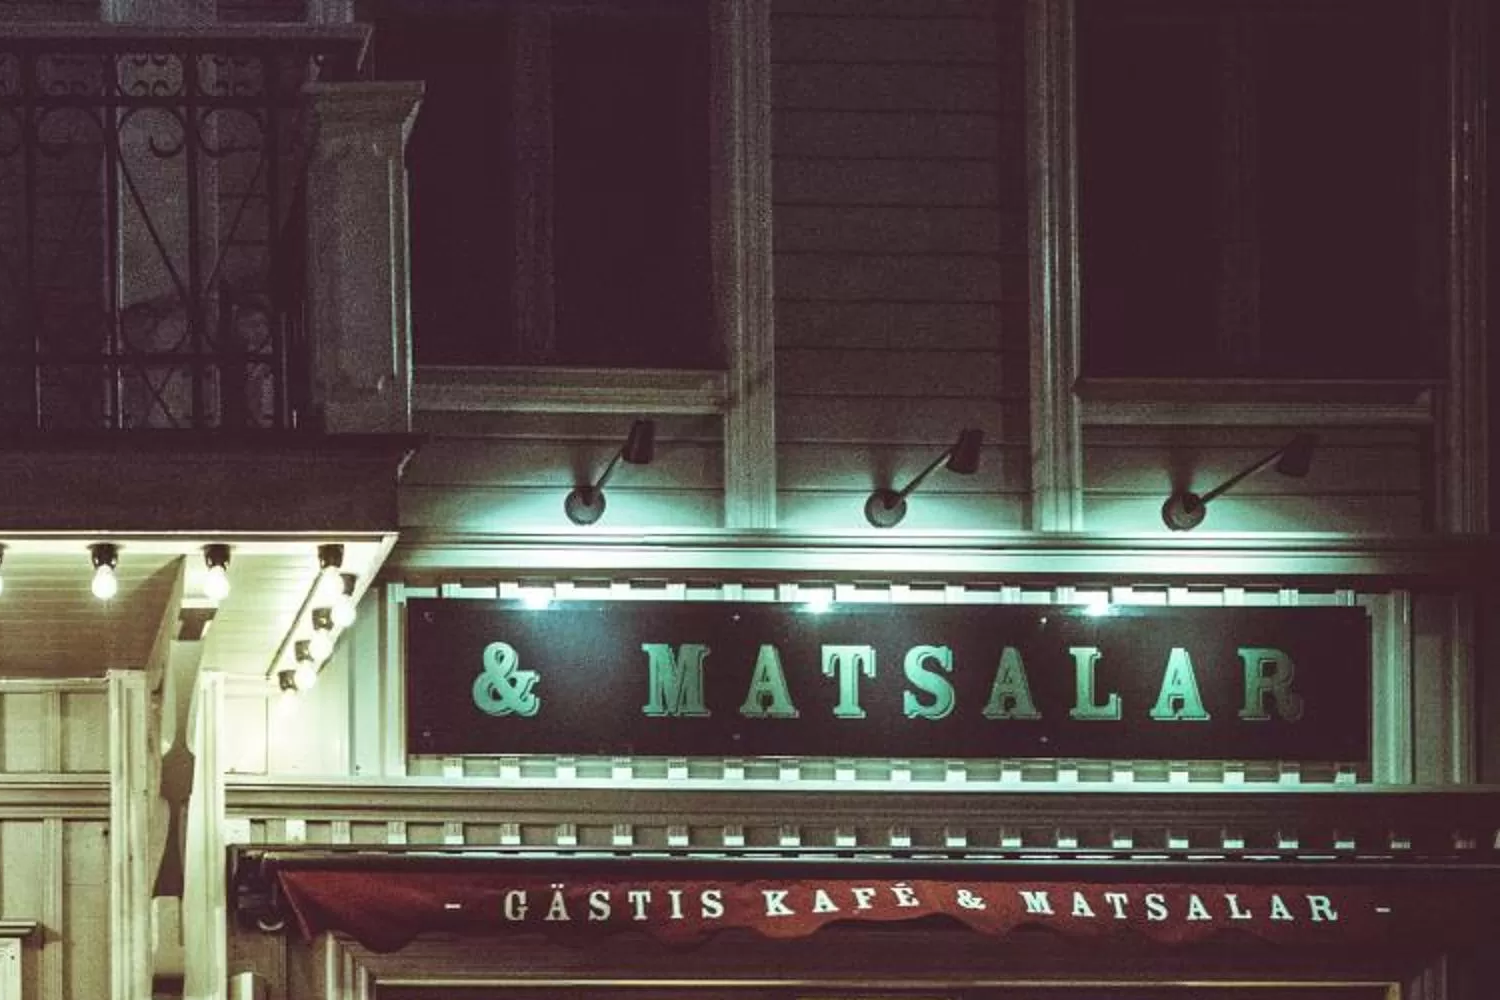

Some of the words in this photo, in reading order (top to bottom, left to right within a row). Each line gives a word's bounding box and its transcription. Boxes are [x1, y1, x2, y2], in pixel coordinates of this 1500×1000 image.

[472, 641, 541, 717] &
[640, 642, 1304, 723] MATSALAR
[503, 882, 725, 922] GÄSTIS
[761, 881, 920, 917] KAFÉ
[955, 888, 987, 911] &
[1017, 890, 1339, 922] MATSALAR
